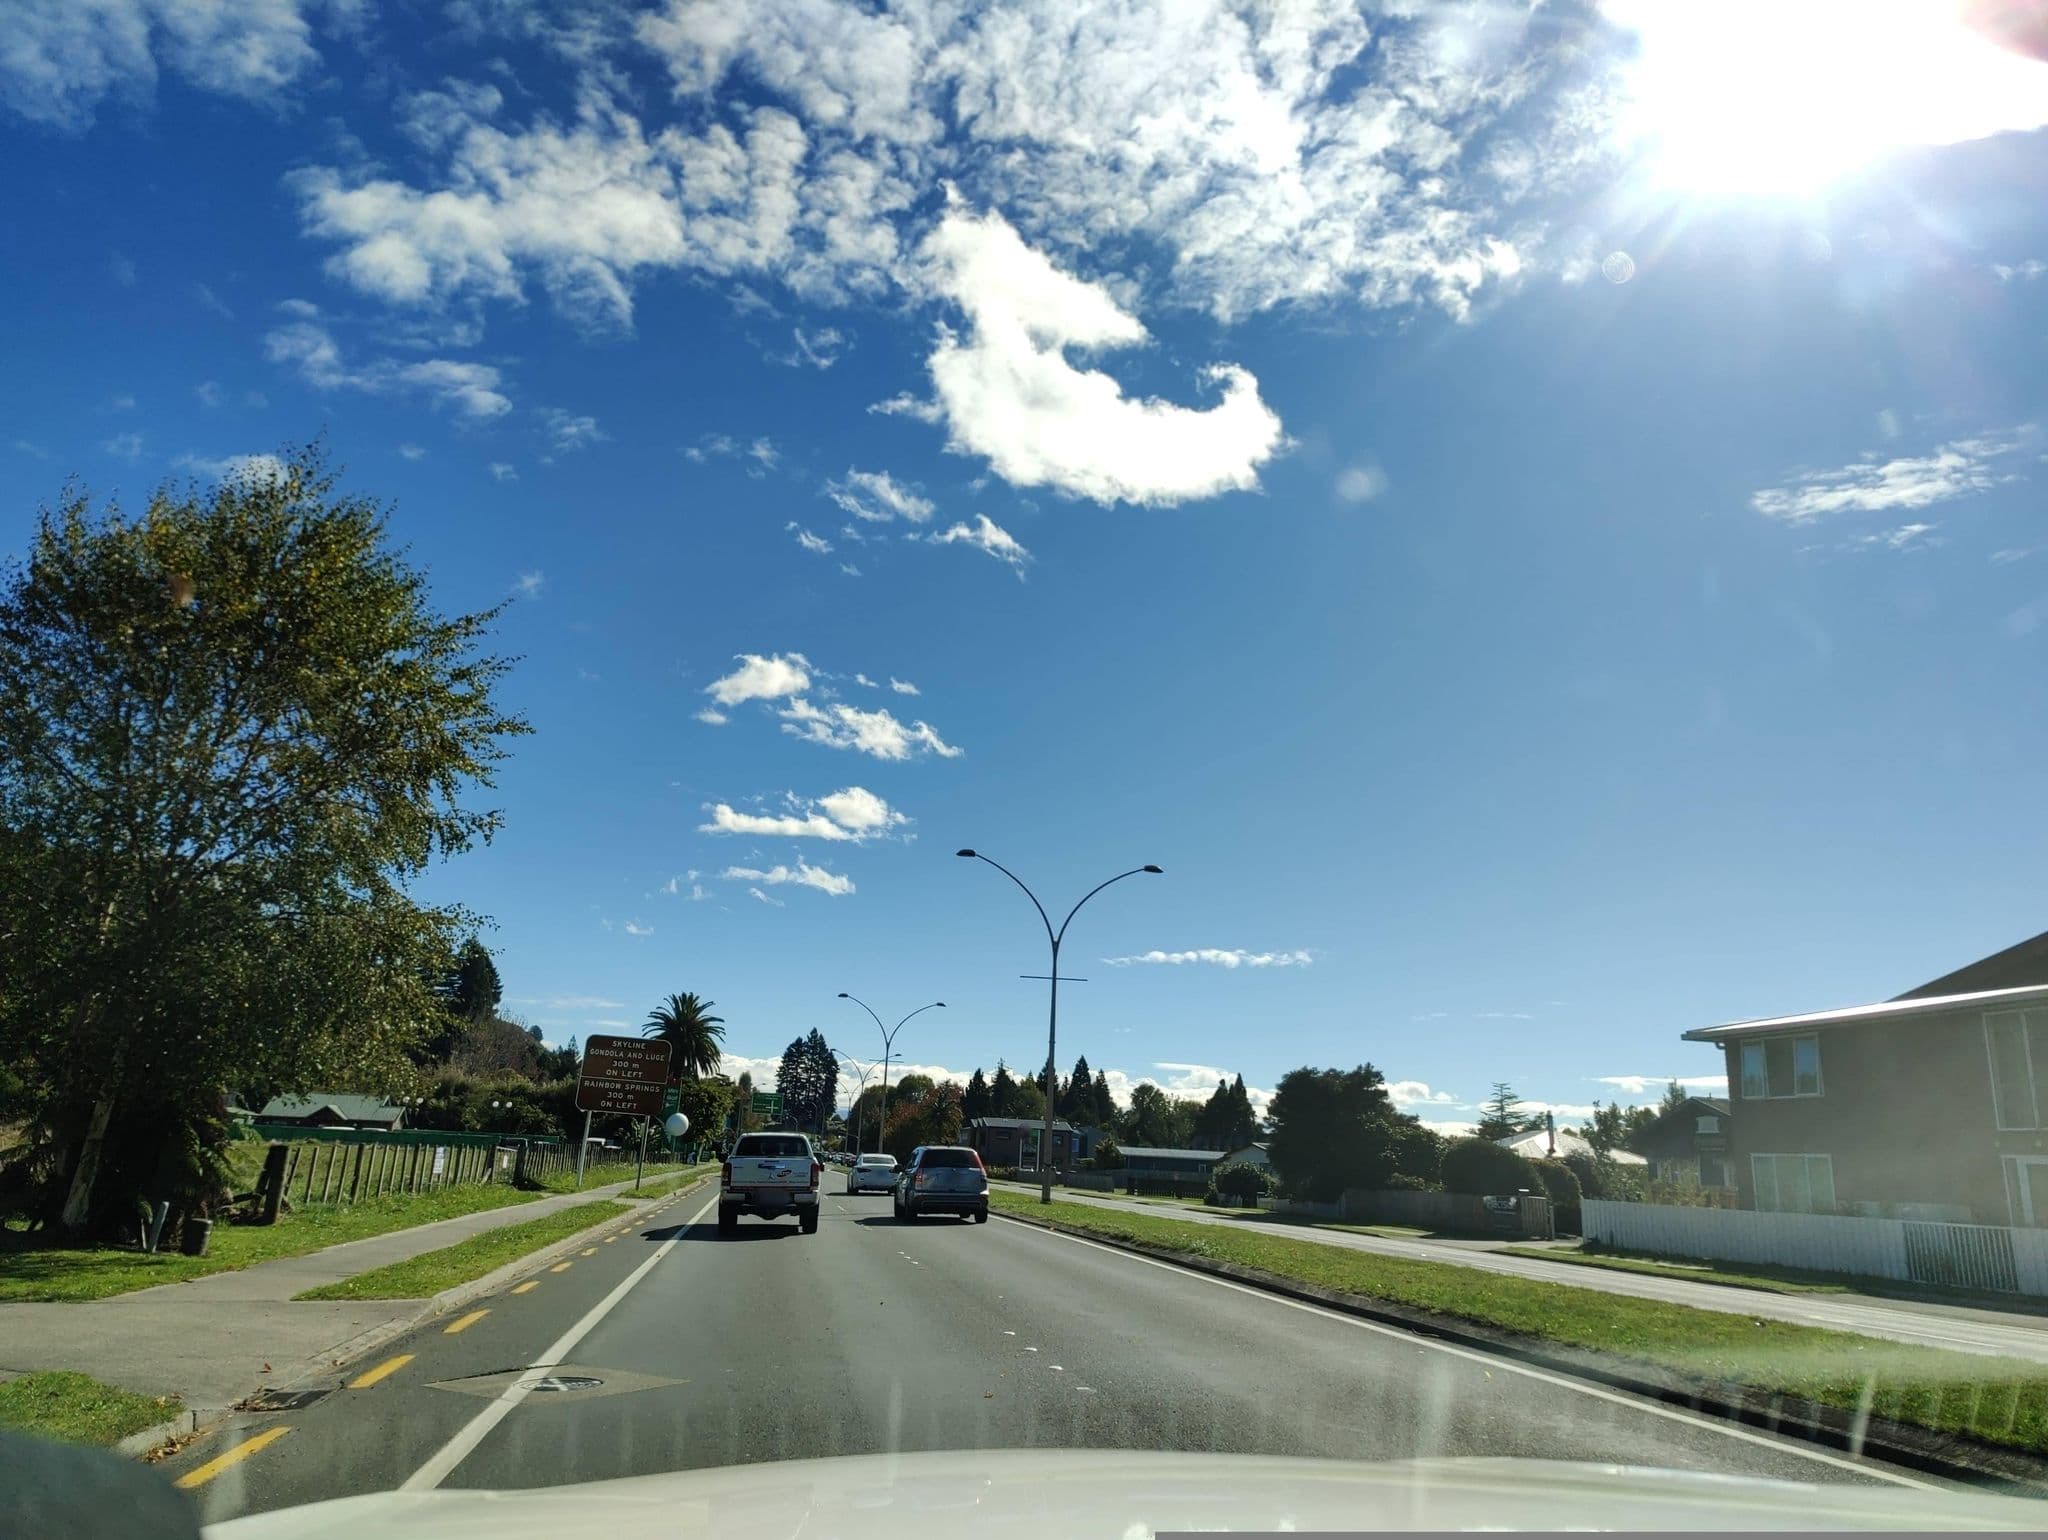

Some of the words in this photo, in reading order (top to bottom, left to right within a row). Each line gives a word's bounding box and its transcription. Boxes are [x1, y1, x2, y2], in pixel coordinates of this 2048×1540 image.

[611, 1040, 646, 1049] SKYLINE
[589, 1048, 624, 1057] GONDOLA
[621, 1070, 643, 1078] LEFT
[584, 1080, 621, 1089] RAINBOW
[624, 1084, 660, 1093] SPRINGS
